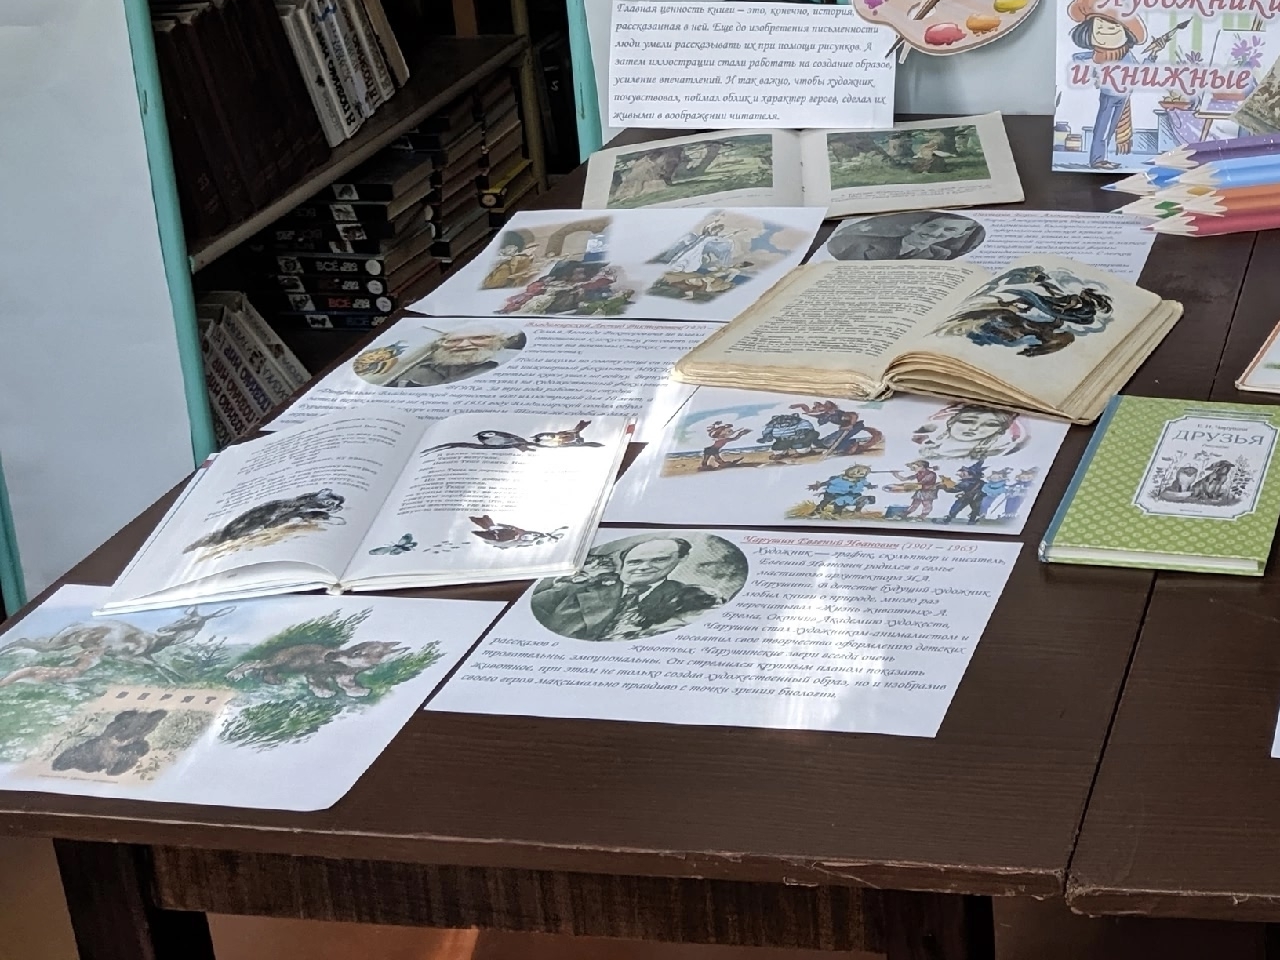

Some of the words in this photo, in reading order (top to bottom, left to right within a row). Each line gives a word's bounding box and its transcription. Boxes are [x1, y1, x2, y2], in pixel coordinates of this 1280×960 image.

[1070, 64, 1093, 87] и
[1099, 61, 1252, 95] книжные
[1172, 430, 1265, 445] ДРУЗЬЯ
